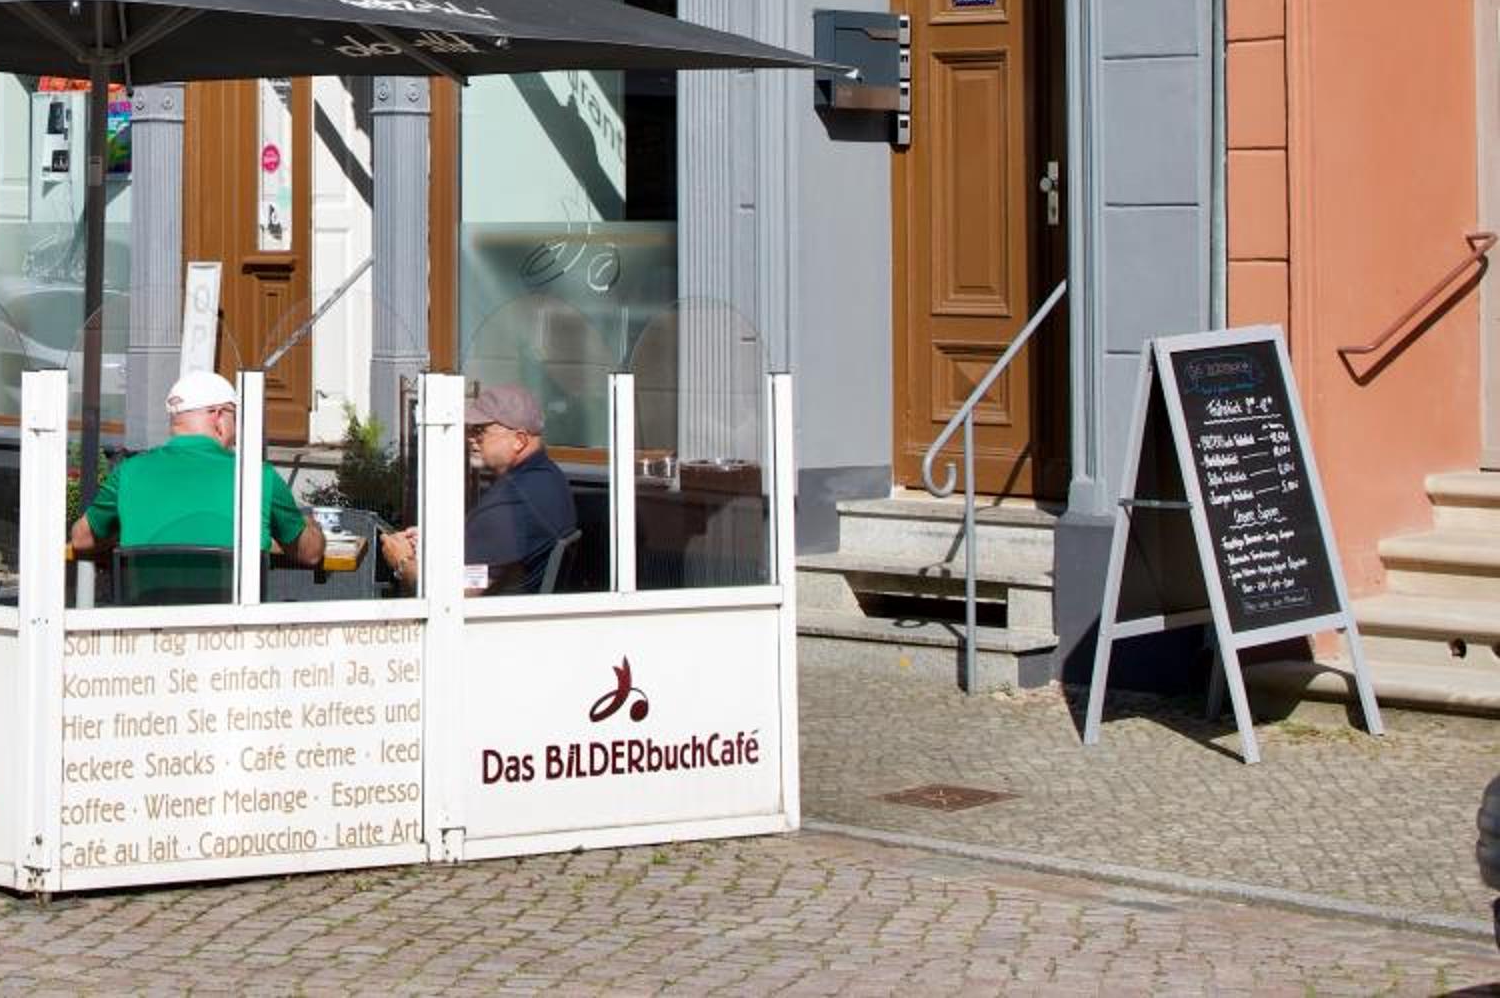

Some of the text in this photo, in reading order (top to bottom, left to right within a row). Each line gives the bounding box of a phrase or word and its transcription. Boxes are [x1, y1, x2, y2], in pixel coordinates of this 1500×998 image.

[197, 628, 245, 651] noch
[63, 658, 420, 699] Kommen Sie einfach rein! Ja, Sie!
[62, 698, 421, 742] Hier finden Sie feinste Kaffees und
[145, 750, 215, 778] Snacks
[240, 743, 286, 772] Café
[296, 742, 356, 769] crème
[381, 737, 420, 763] Iced
[482, 749, 535, 784] Das
[60, 781, 420, 825] coffee Wiener Melange Espresso
[60, 817, 420, 867] Café au lait Cappuccino Latte Art
